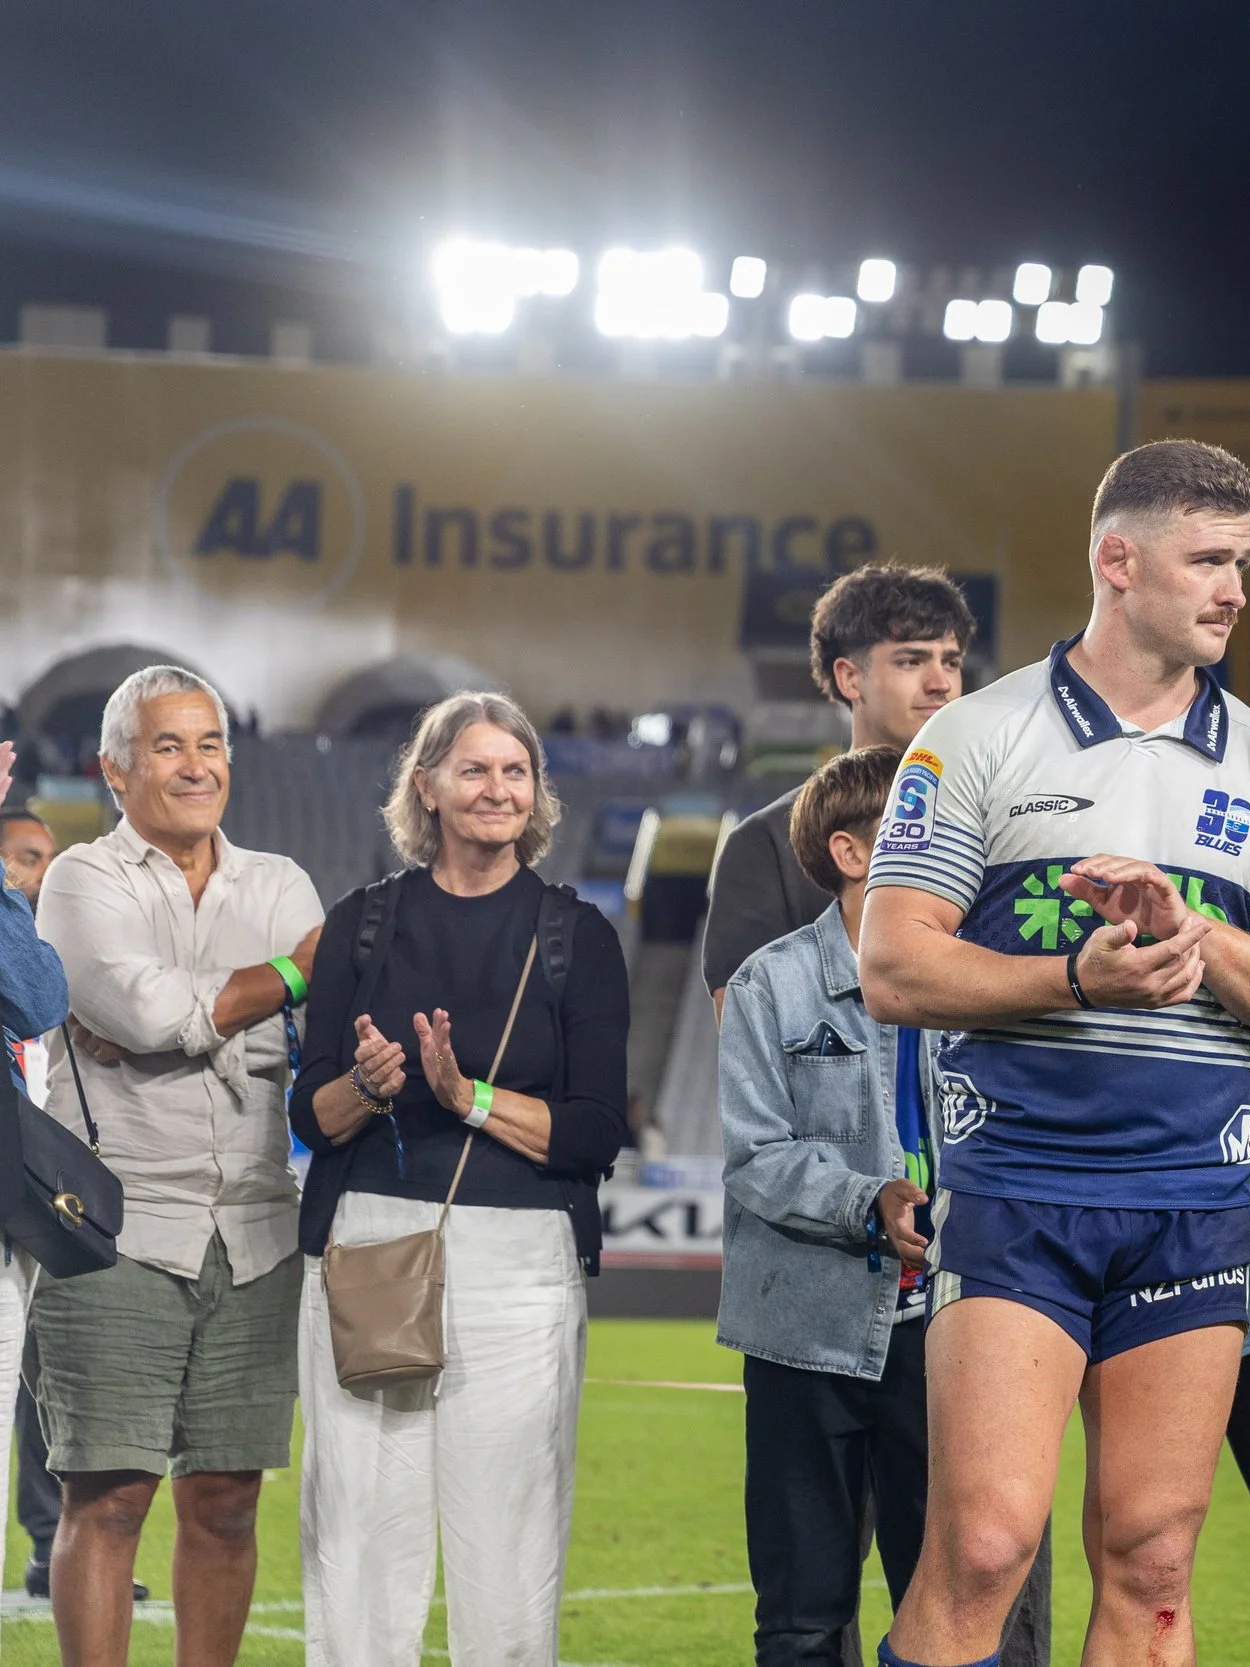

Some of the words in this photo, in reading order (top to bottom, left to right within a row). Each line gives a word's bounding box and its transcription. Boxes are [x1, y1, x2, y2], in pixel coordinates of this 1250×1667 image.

[190, 476, 325, 562] AA
[391, 482, 880, 575] Insurance
[1063, 698, 1094, 738] Airwallex
[1207, 704, 1221, 743] Airwallex
[908, 752, 934, 765] DHL
[1009, 799, 1069, 818] CLASSIC
[889, 822, 926, 839] 30
[886, 842, 919, 850] YEARS
[1194, 833, 1243, 857] BLUES
